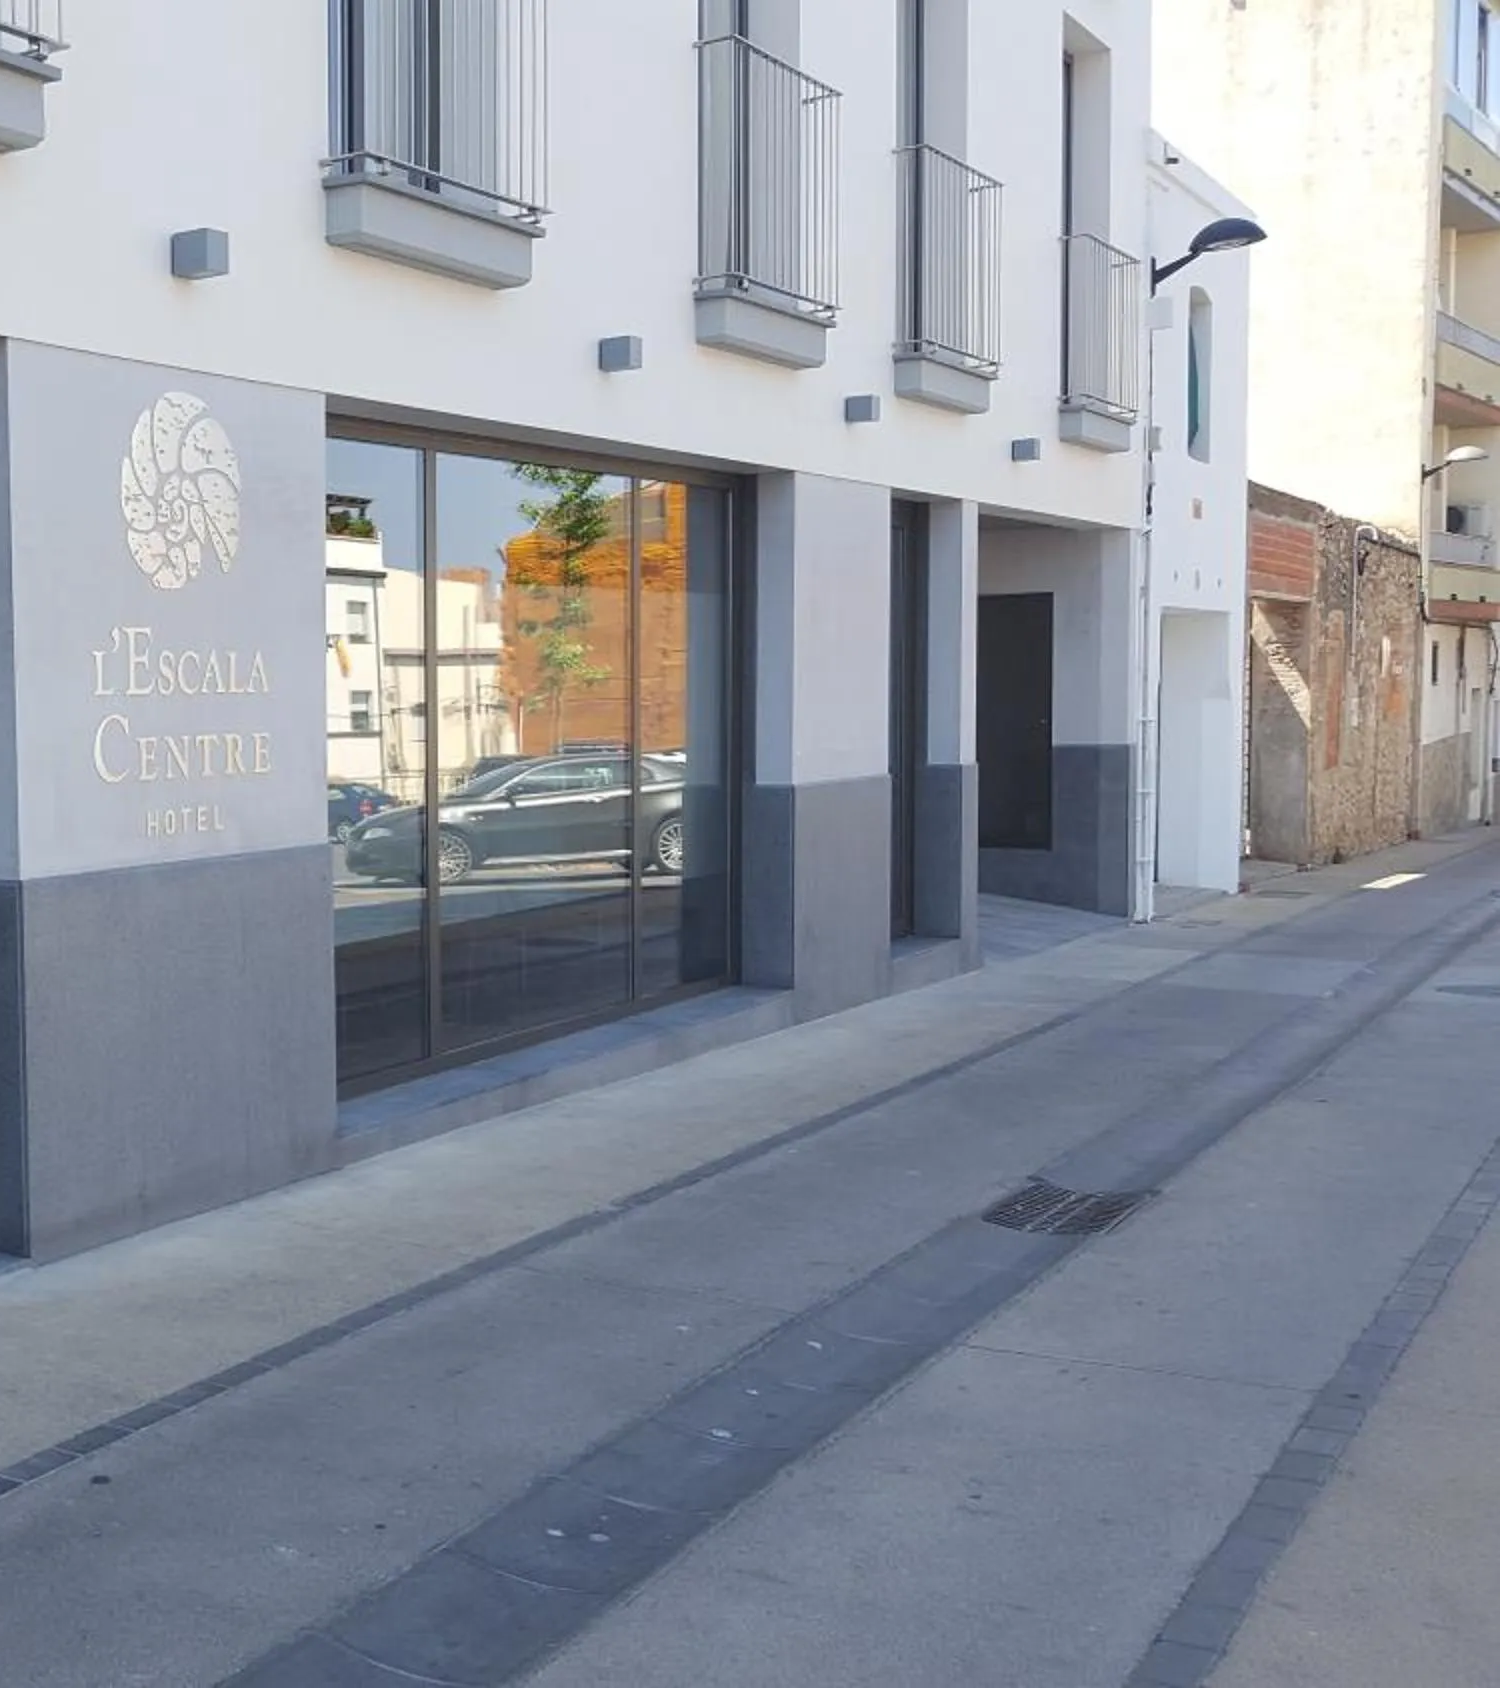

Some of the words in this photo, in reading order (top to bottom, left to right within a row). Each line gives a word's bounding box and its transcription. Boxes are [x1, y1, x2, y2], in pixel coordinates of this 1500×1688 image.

[91, 626, 269, 696] L'ESCALA
[93, 714, 272, 783] CENTRE
[146, 804, 225, 836] HOTEL
